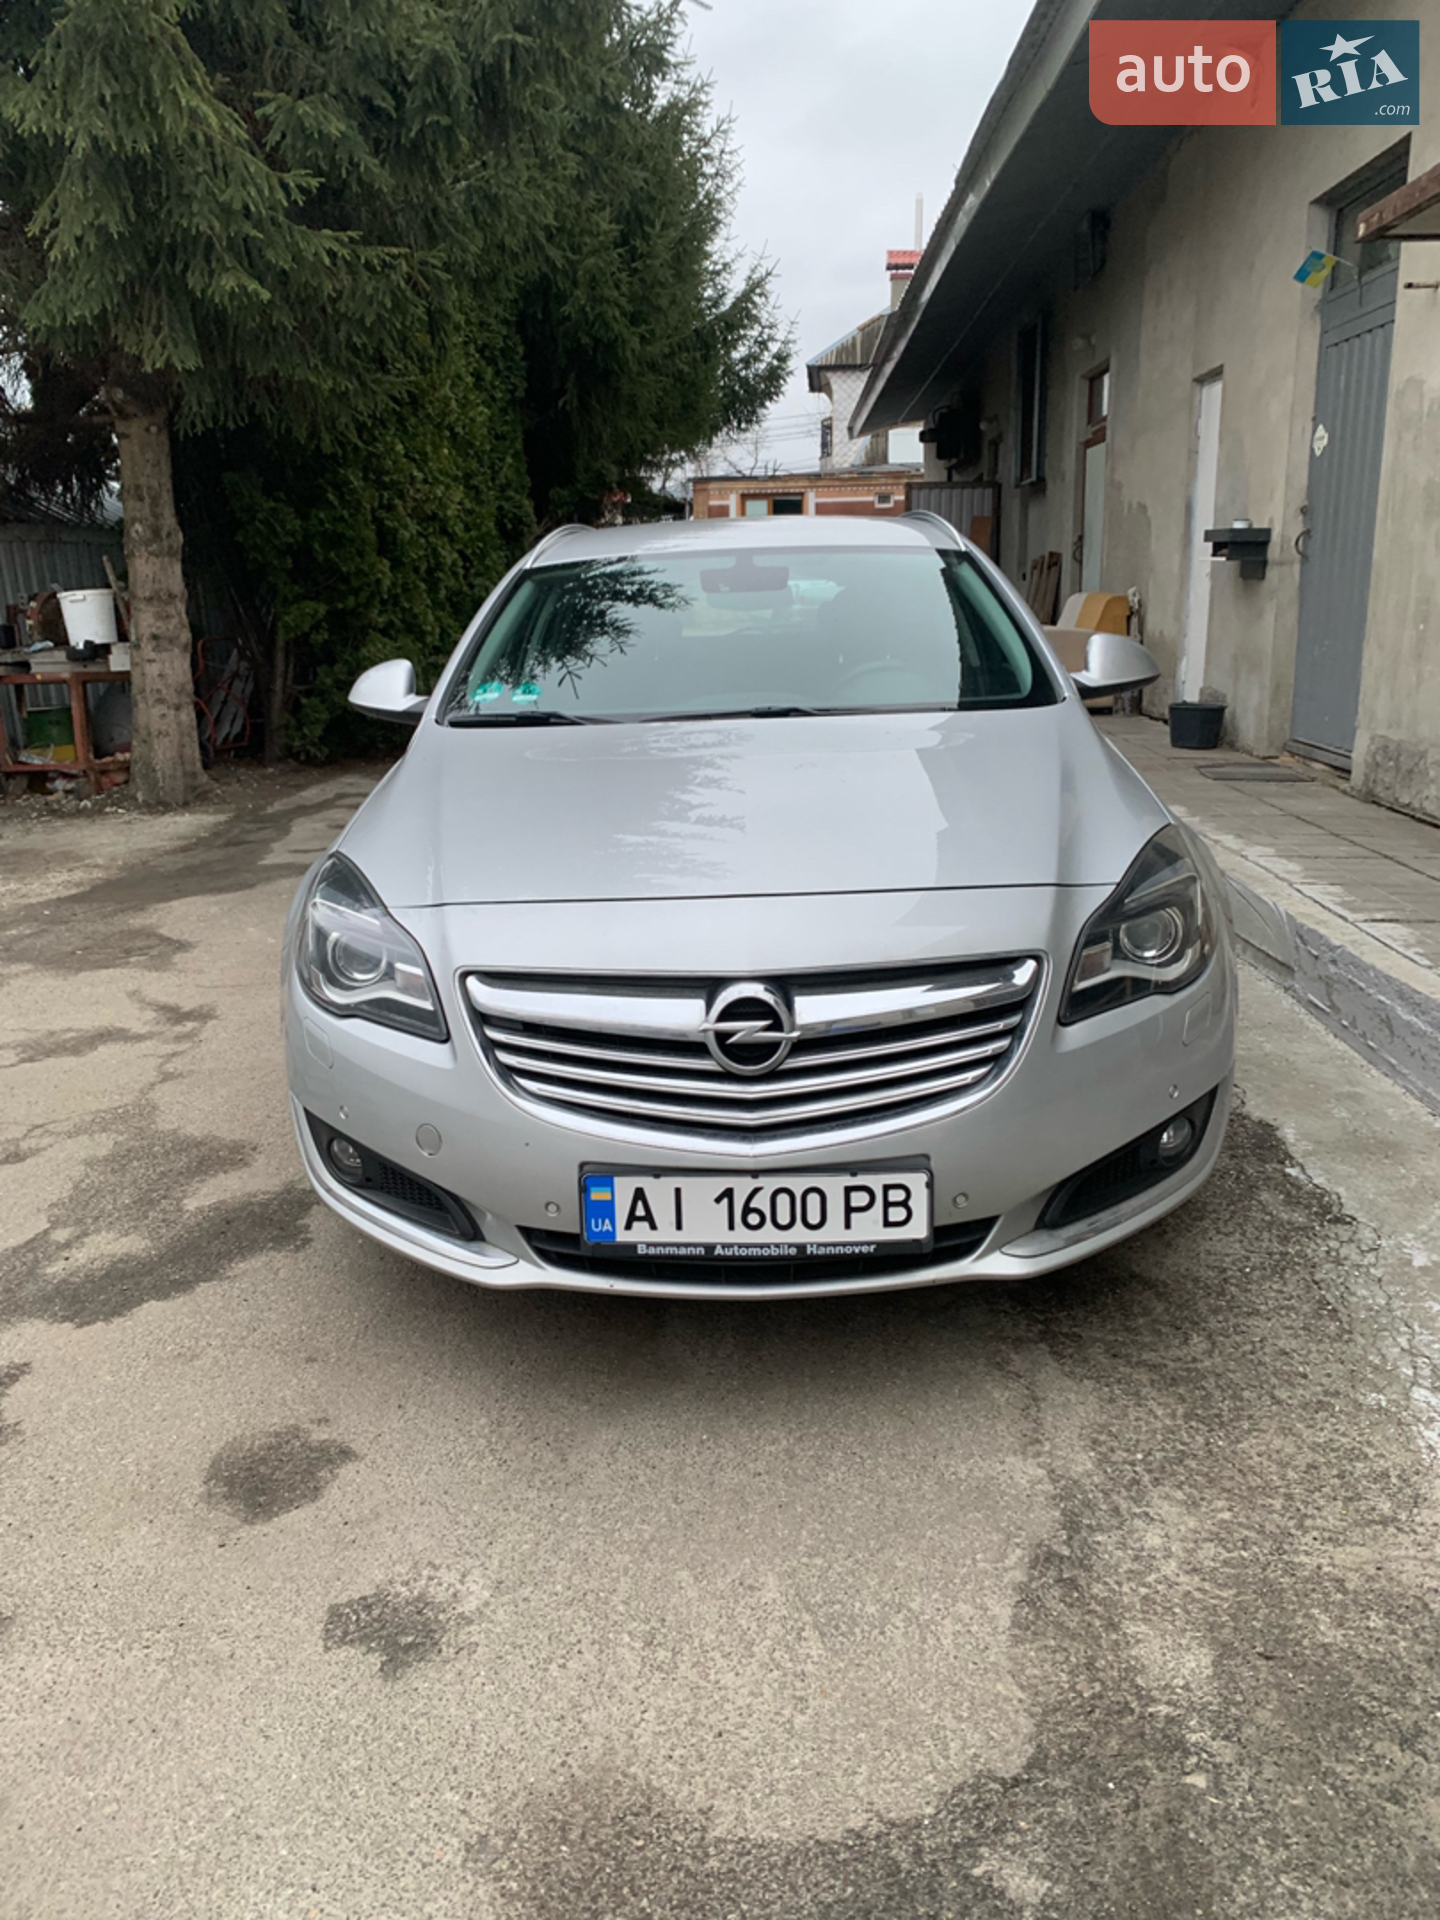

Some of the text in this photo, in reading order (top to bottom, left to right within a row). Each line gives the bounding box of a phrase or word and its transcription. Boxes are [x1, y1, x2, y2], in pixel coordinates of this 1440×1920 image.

[624, 1184, 913, 1231] AI 1600 PB
[591, 1219, 613, 1232] UA
[714, 1244, 797, 1257] Automobile
[806, 1243, 877, 1255] Hannover
